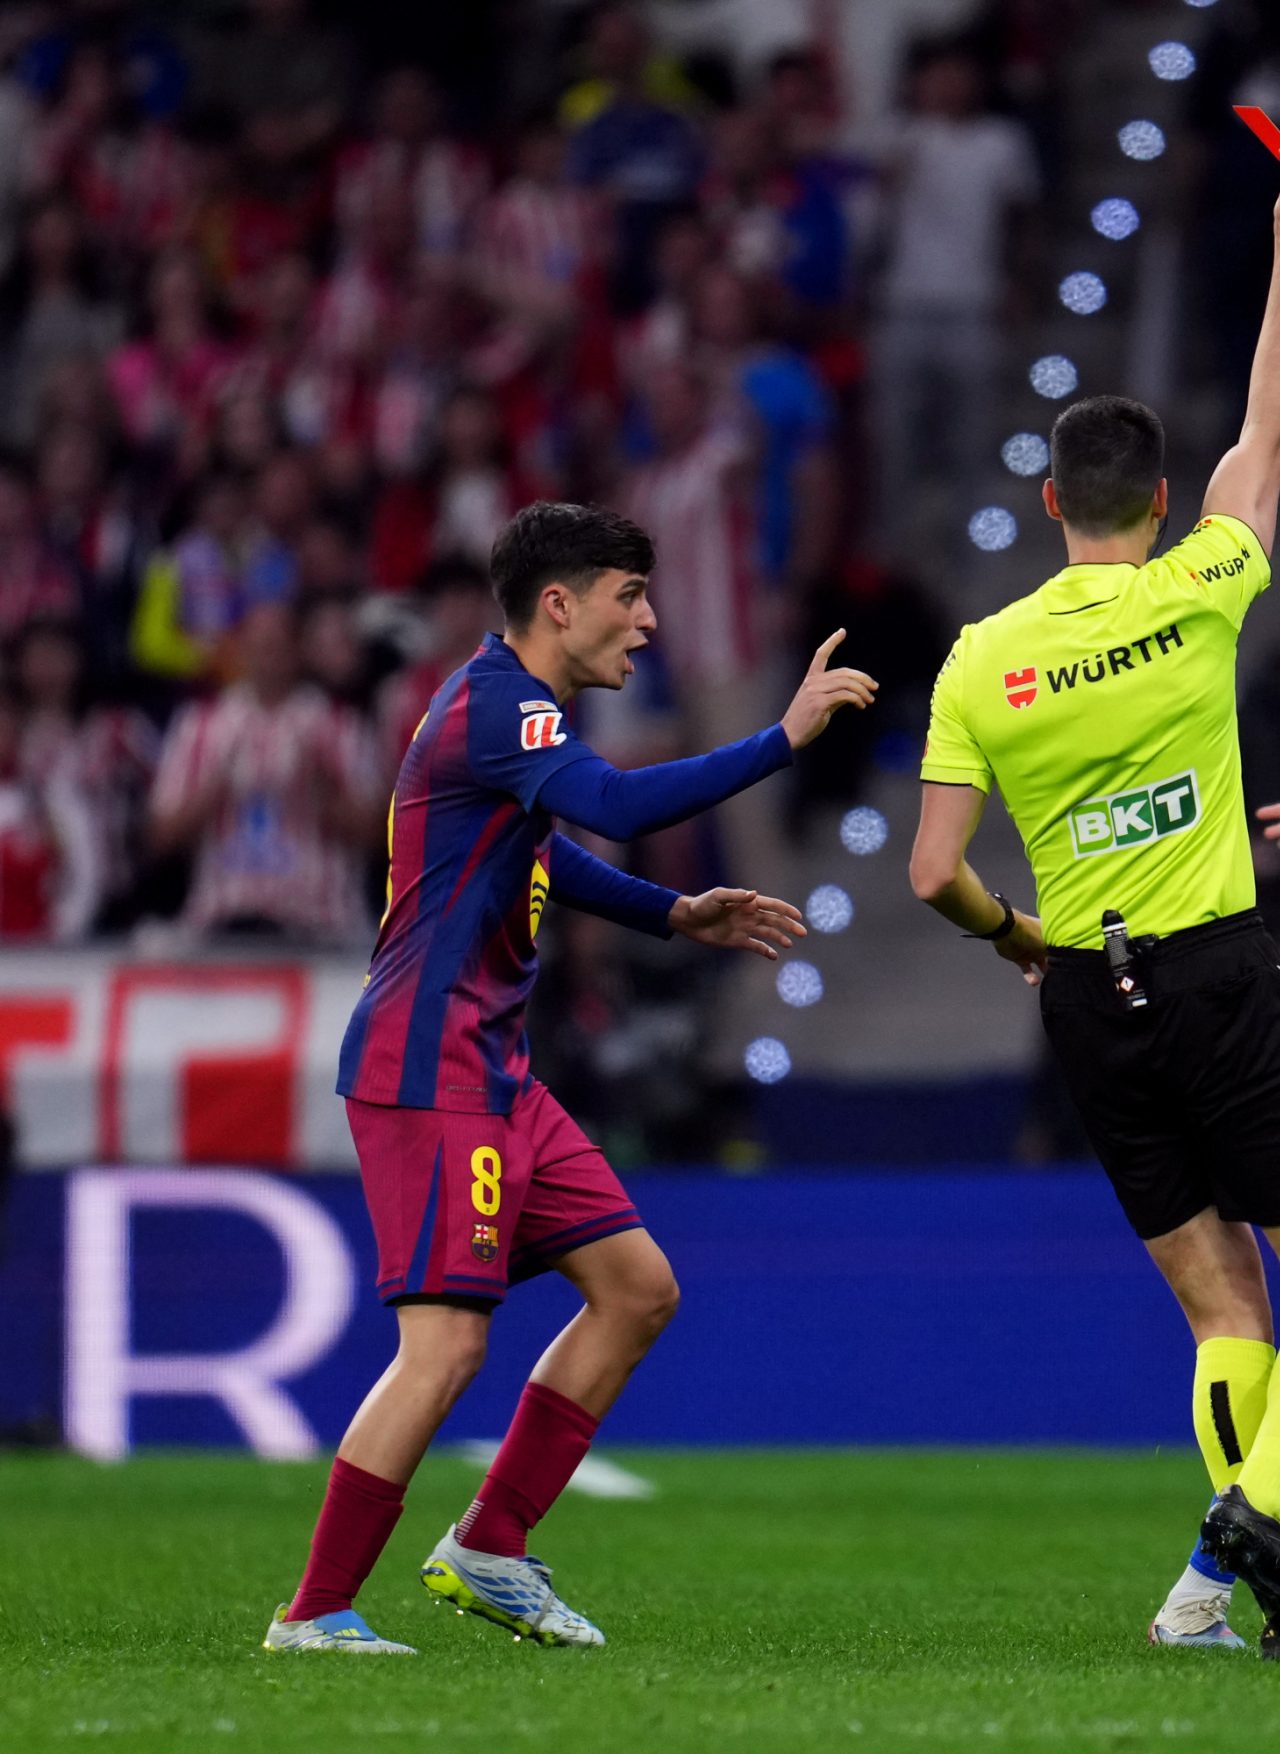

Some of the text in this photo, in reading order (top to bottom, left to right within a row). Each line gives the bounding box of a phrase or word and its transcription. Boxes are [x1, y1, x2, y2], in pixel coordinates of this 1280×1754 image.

[1046, 623, 1185, 695] WÜRTH
[1075, 785, 1190, 845] BKT
[471, 1146, 502, 1216] 8
[64, 1167, 354, 1461] R
